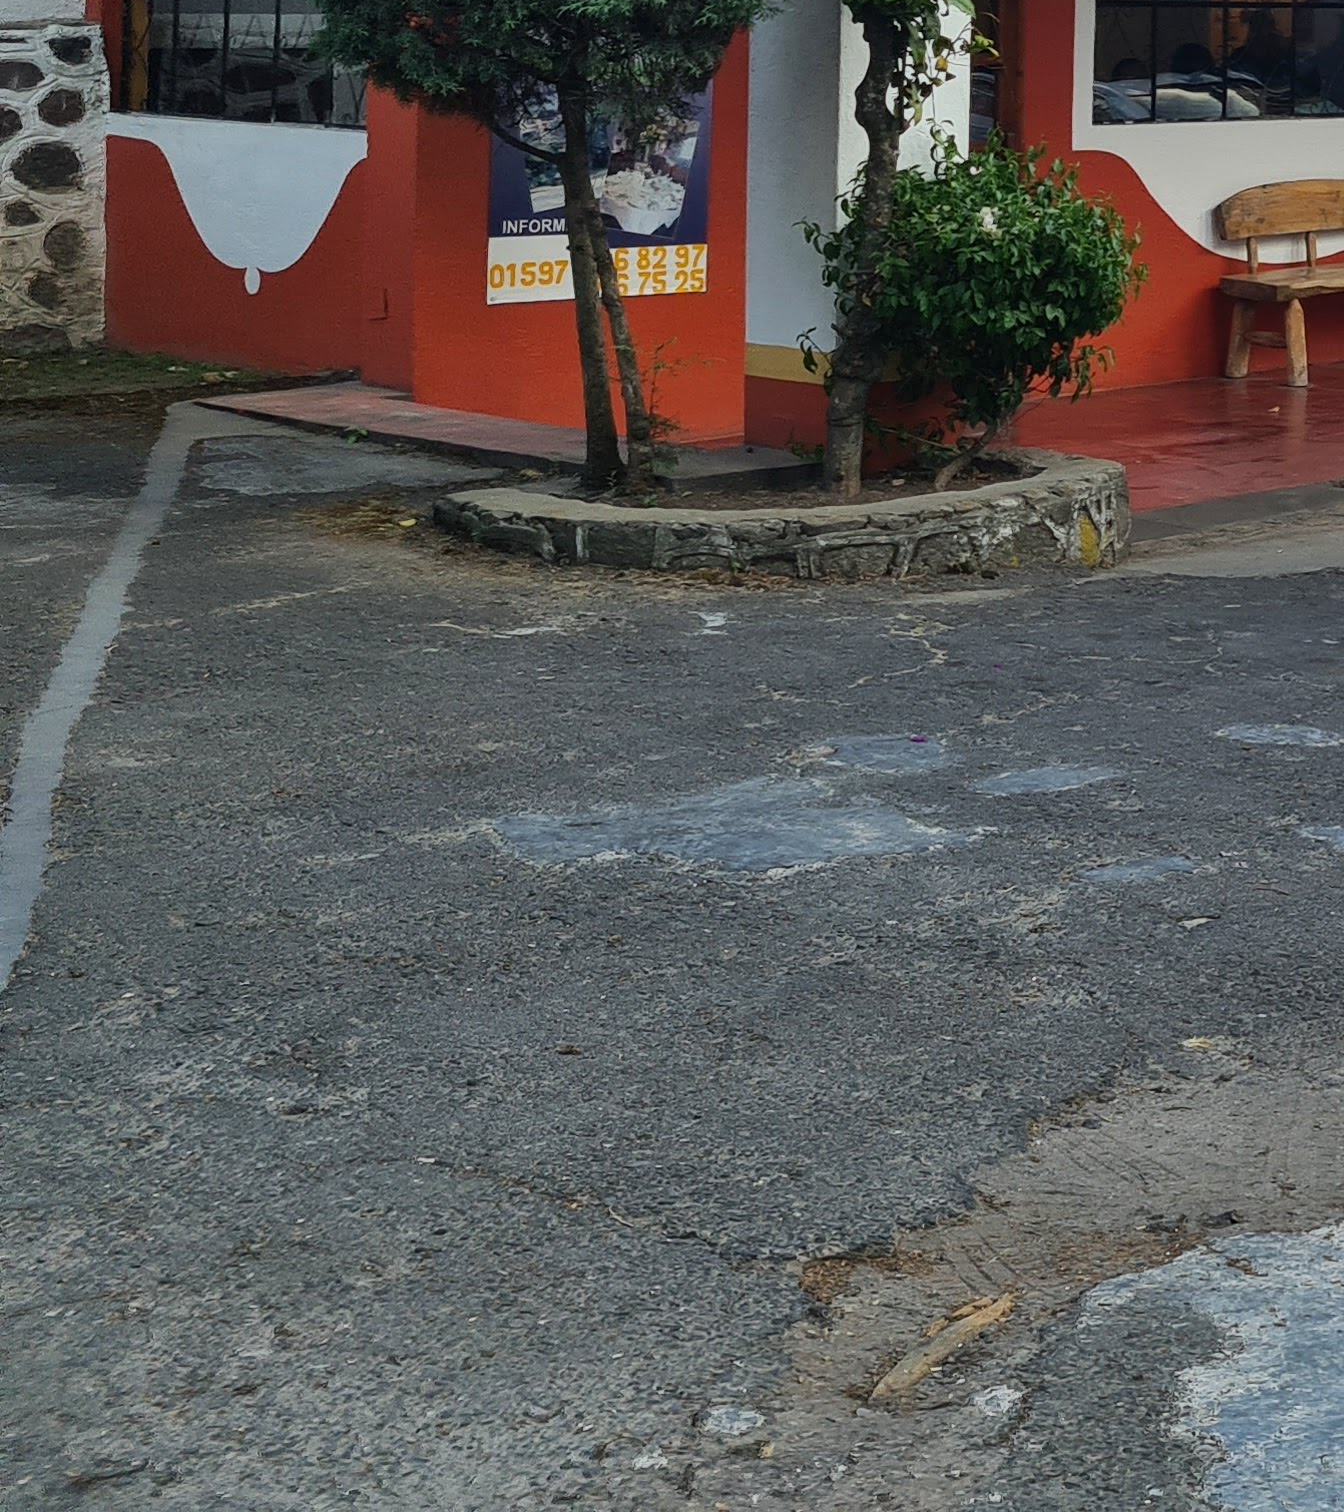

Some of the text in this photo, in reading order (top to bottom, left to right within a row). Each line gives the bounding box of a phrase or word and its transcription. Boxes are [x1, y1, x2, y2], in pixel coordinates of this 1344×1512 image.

[502, 218, 568, 234] INFORM
[637, 246, 667, 270] 82
[675, 245, 705, 268] 97
[489, 260, 569, 289] 01597
[638, 271, 667, 296] 75
[675, 269, 704, 294] 25
